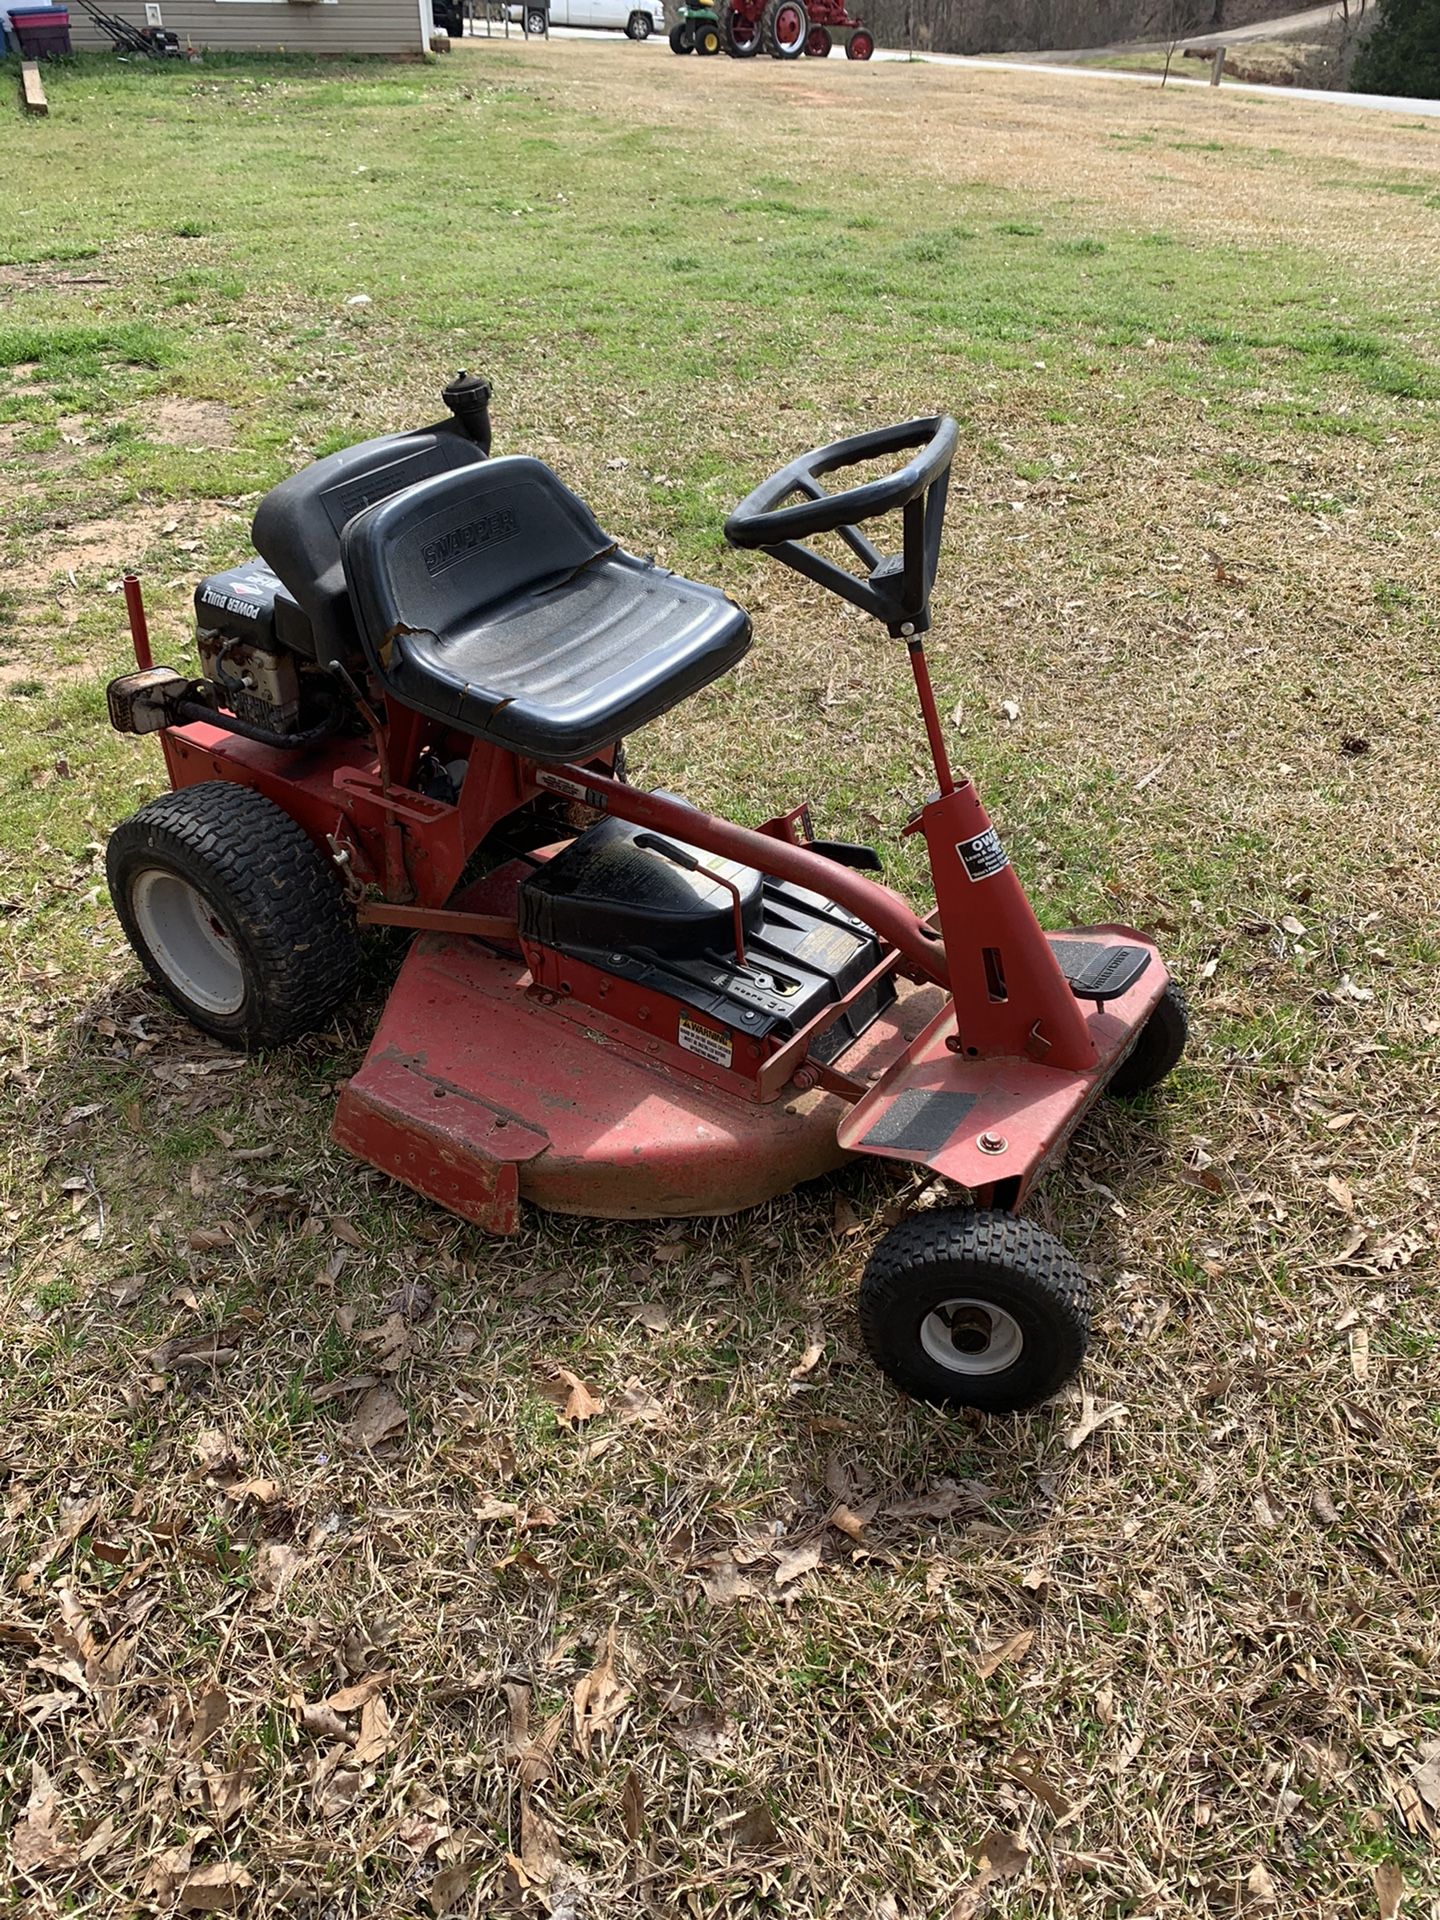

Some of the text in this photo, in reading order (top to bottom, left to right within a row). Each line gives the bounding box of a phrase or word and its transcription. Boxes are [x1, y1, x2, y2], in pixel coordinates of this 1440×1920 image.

[423, 510, 514, 565] SNAPPER
[201, 587, 260, 619] POWER BUILT
